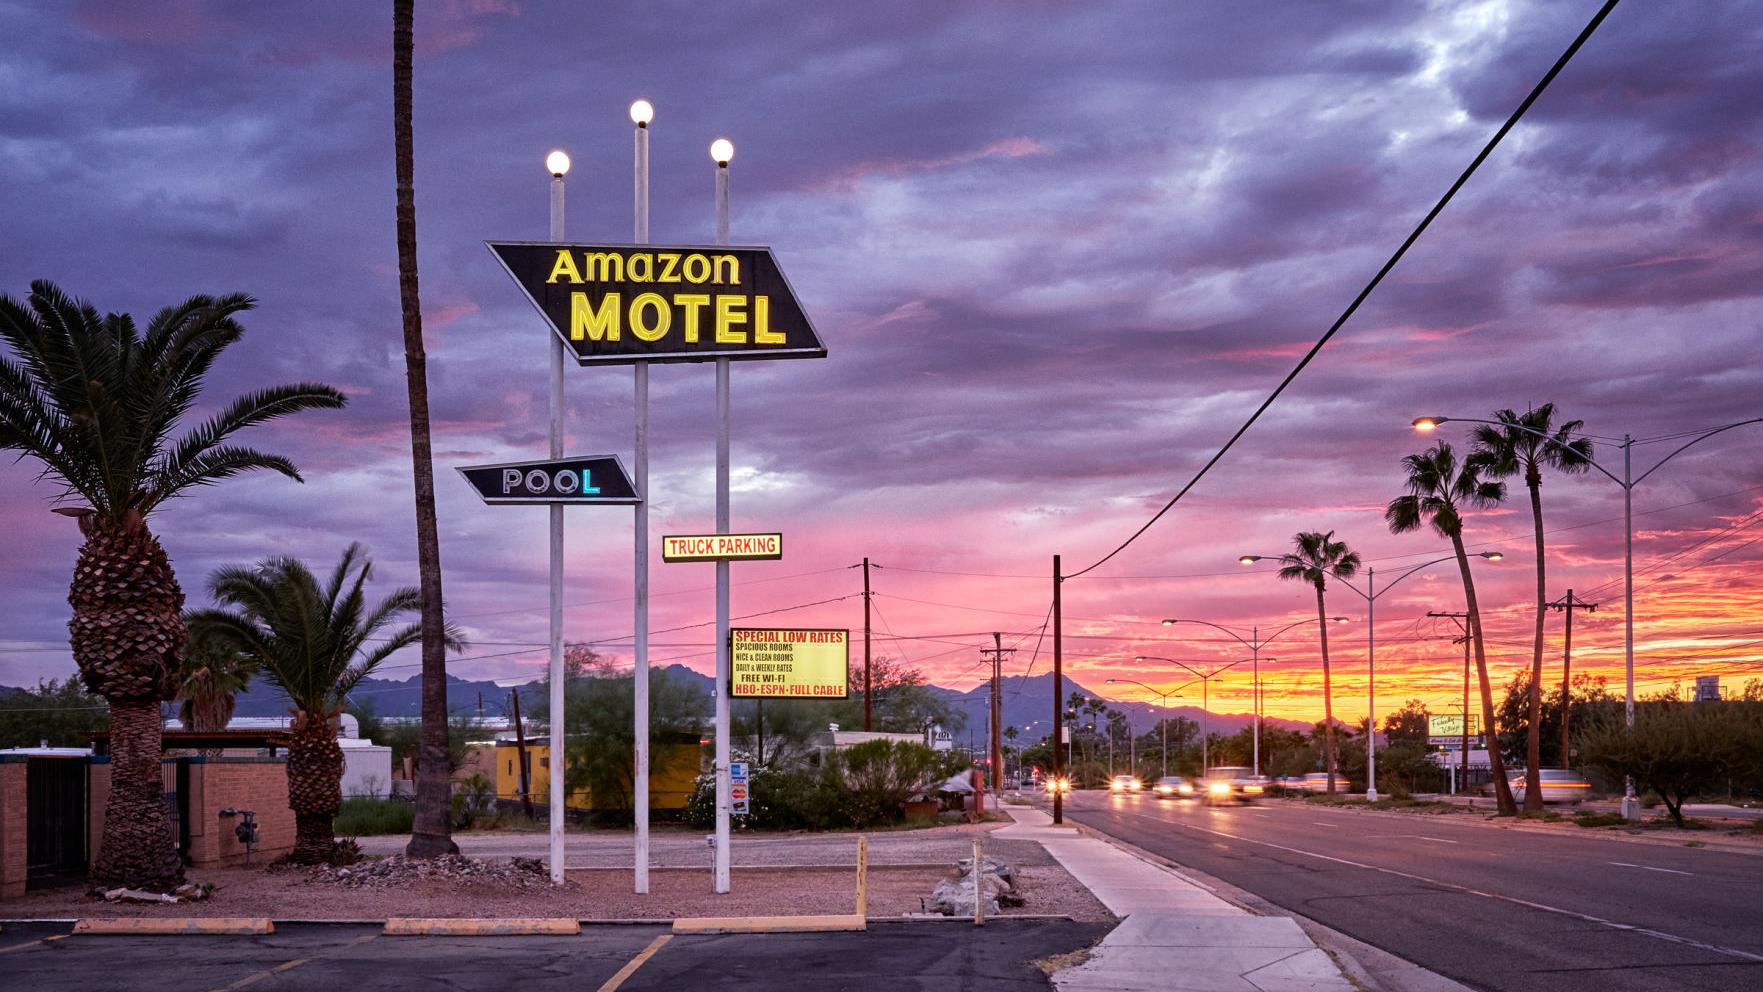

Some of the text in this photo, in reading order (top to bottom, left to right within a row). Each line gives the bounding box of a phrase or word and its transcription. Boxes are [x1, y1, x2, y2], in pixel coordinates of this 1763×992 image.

[545, 249, 742, 285] Amazon
[570, 292, 788, 344] MOTEL
[502, 468, 601, 495] POOL
[670, 537, 776, 555] TRUCK PARKING
[736, 631, 842, 643] SPECIAL LOW RATES
[736, 643, 768, 651] SPACIOUS
[736, 653, 748, 661] NICE
[755, 653, 772, 661] CLEAN
[736, 664, 750, 672] DAILY
[756, 664, 776, 672] WEEKLY
[777, 664, 792, 672] RATES
[741, 674, 785, 682] FREE WI-FI
[813, 685, 843, 695] CABLE
